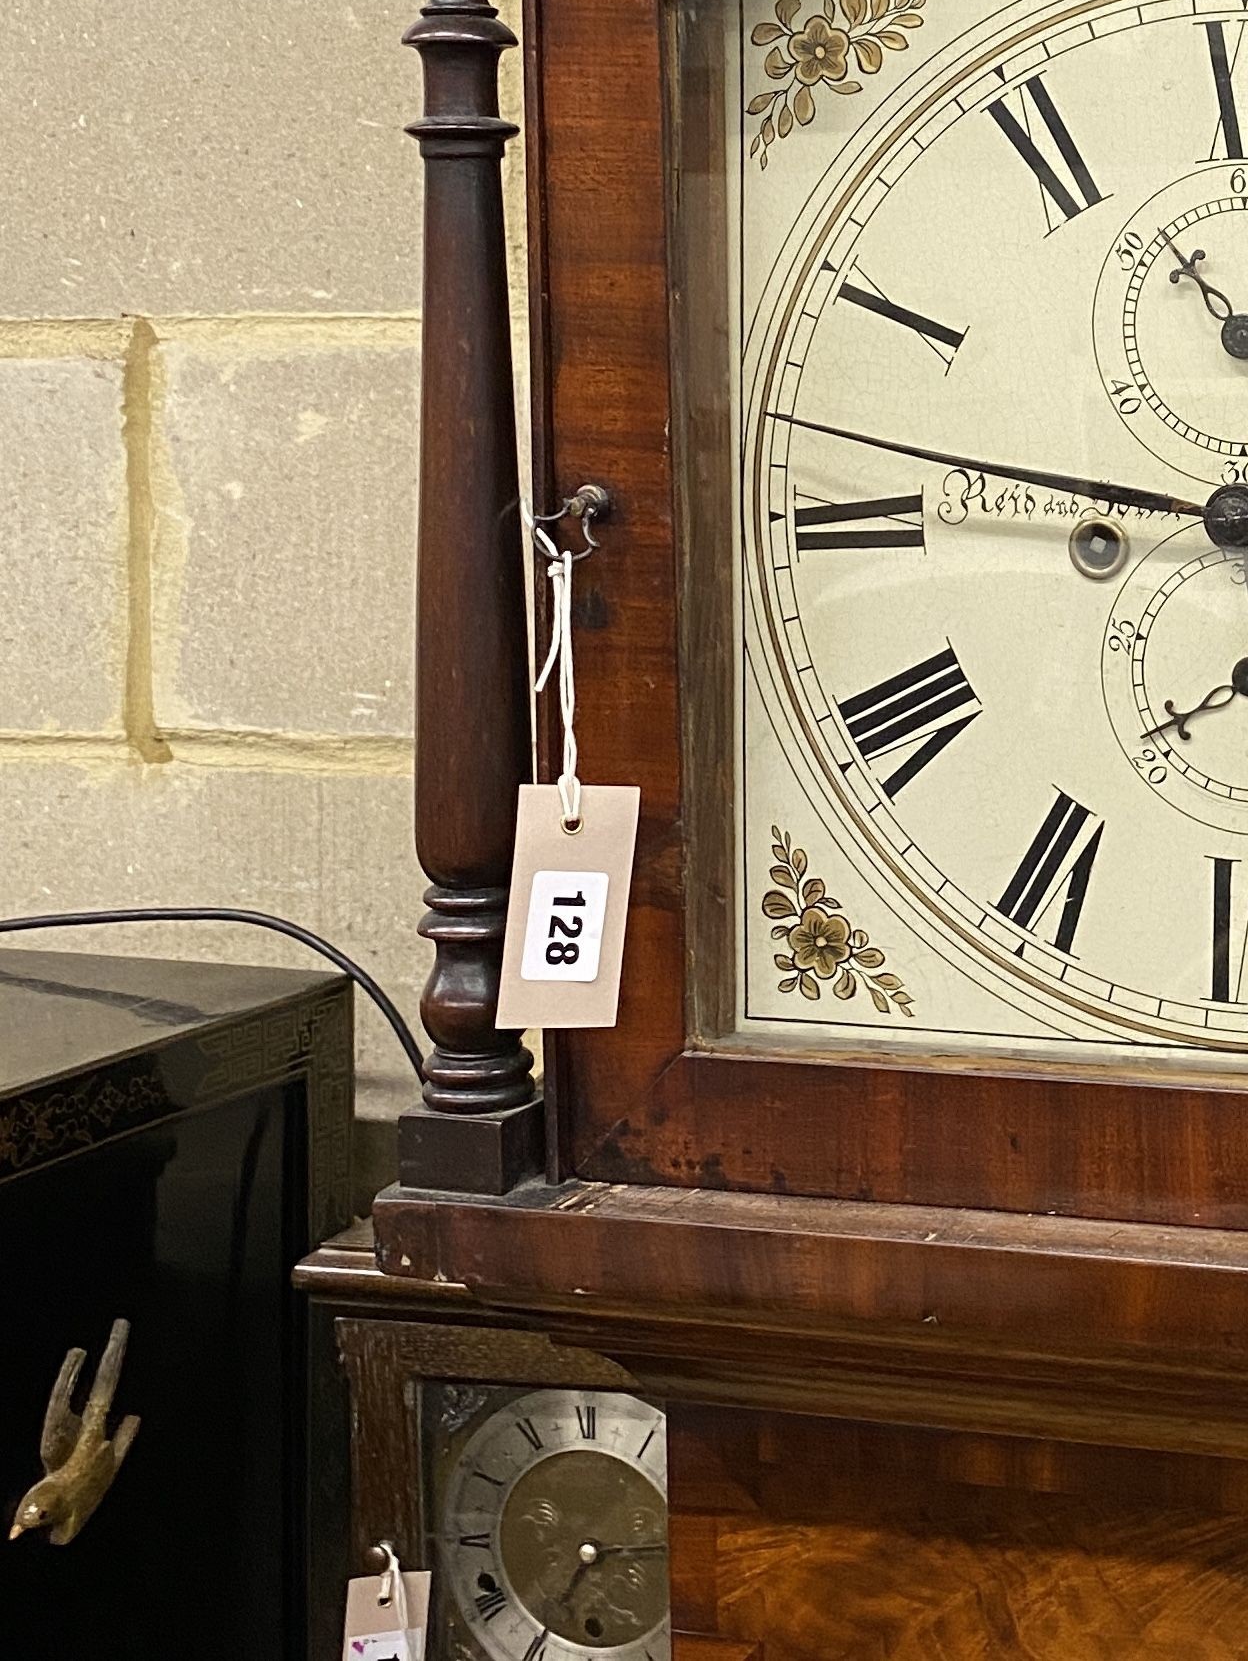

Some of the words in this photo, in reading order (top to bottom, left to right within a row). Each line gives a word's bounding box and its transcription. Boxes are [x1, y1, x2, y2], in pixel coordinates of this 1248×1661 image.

[980, 69, 1115, 239] XI
[1118, 231, 1144, 271] 50
[832, 254, 970, 377] X
[1110, 378, 1142, 415] 40
[794, 484, 926, 563] IX
[1108, 617, 1137, 656] 25
[832, 636, 984, 806] VIII
[1132, 747, 1168, 785] 20
[986, 784, 1106, 961] VII
[545, 890, 586, 965] 128
